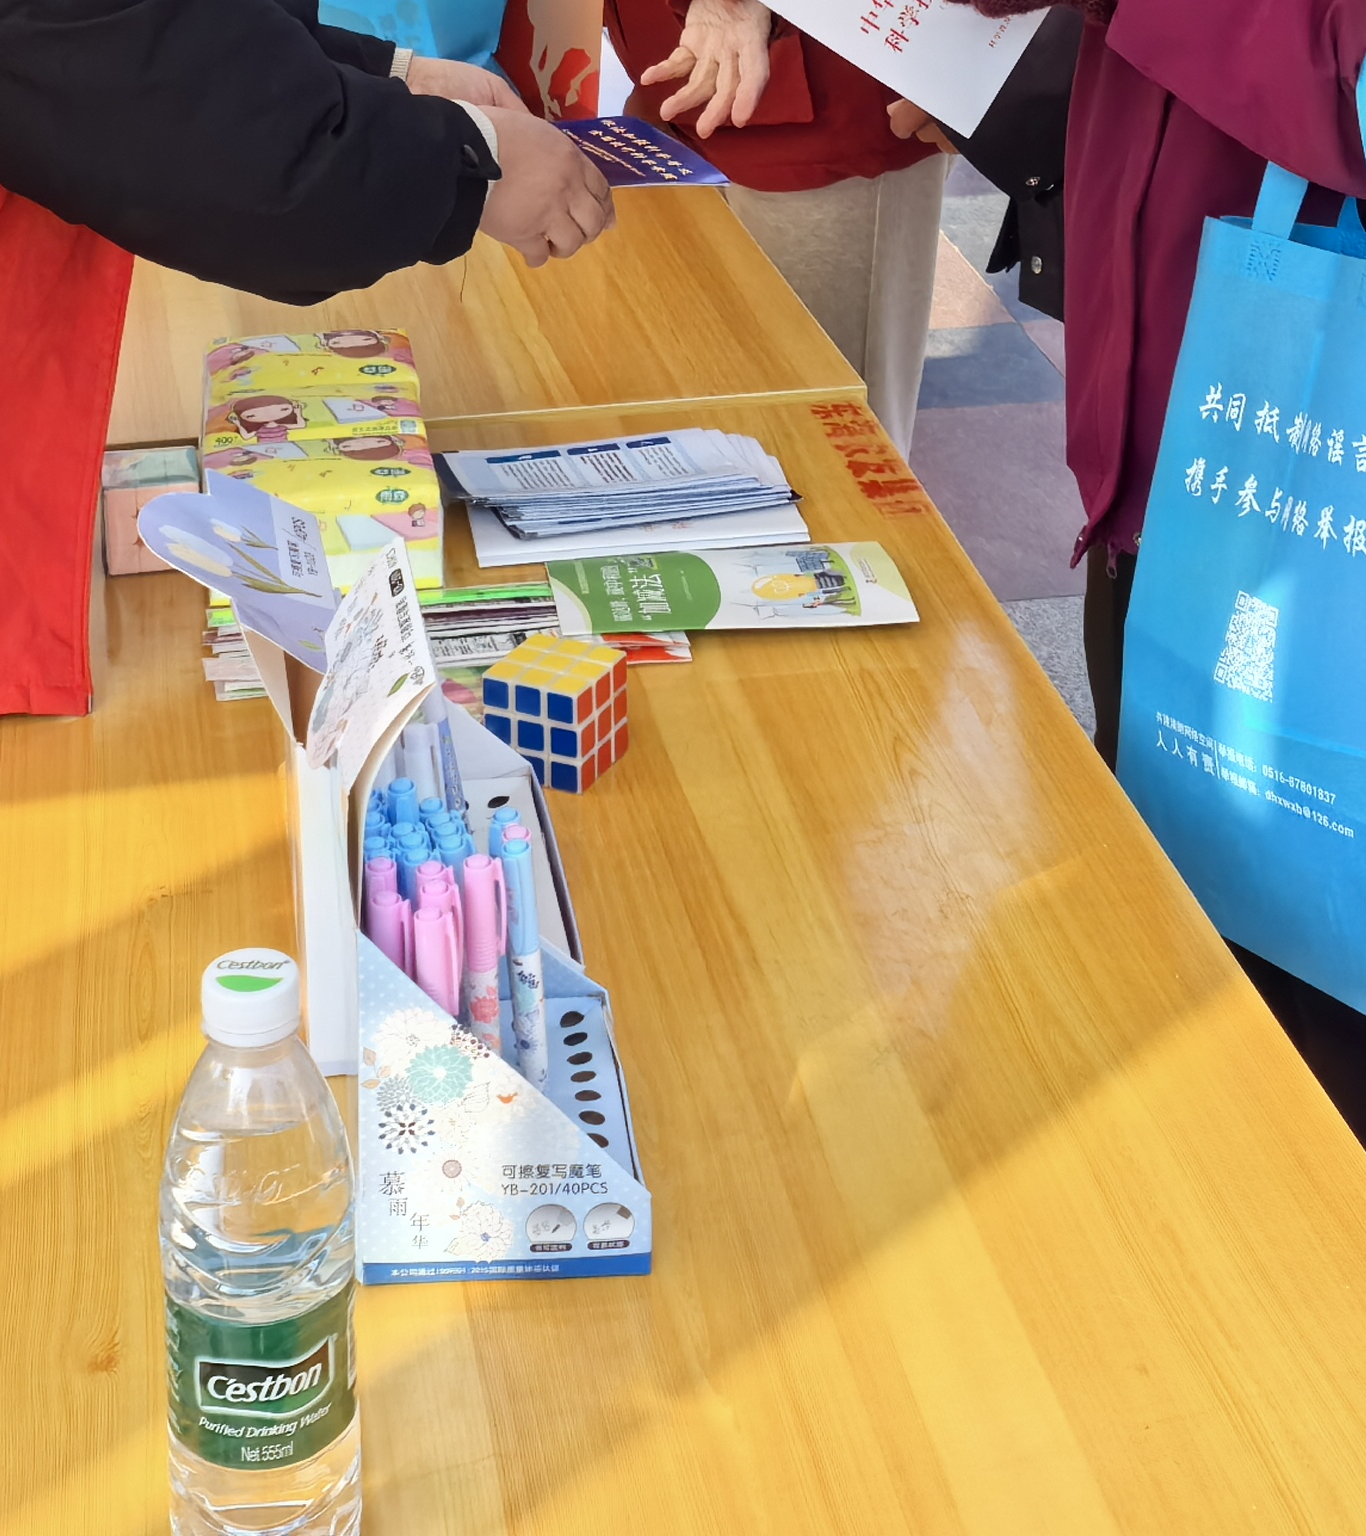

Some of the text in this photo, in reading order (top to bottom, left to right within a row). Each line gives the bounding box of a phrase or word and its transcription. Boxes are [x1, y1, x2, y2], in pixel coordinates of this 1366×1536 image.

[1156, 730, 1216, 776] 人人有责
[501, 1164, 602, 1180] 可擦复写魔笔
[501, 1181, 608, 1196] YB-201/40PCS
[199, 1416, 245, 1438] Purified
[245, 1419, 297, 1438] Drinking
[241, 1440, 294, 1462] Net 555ml
